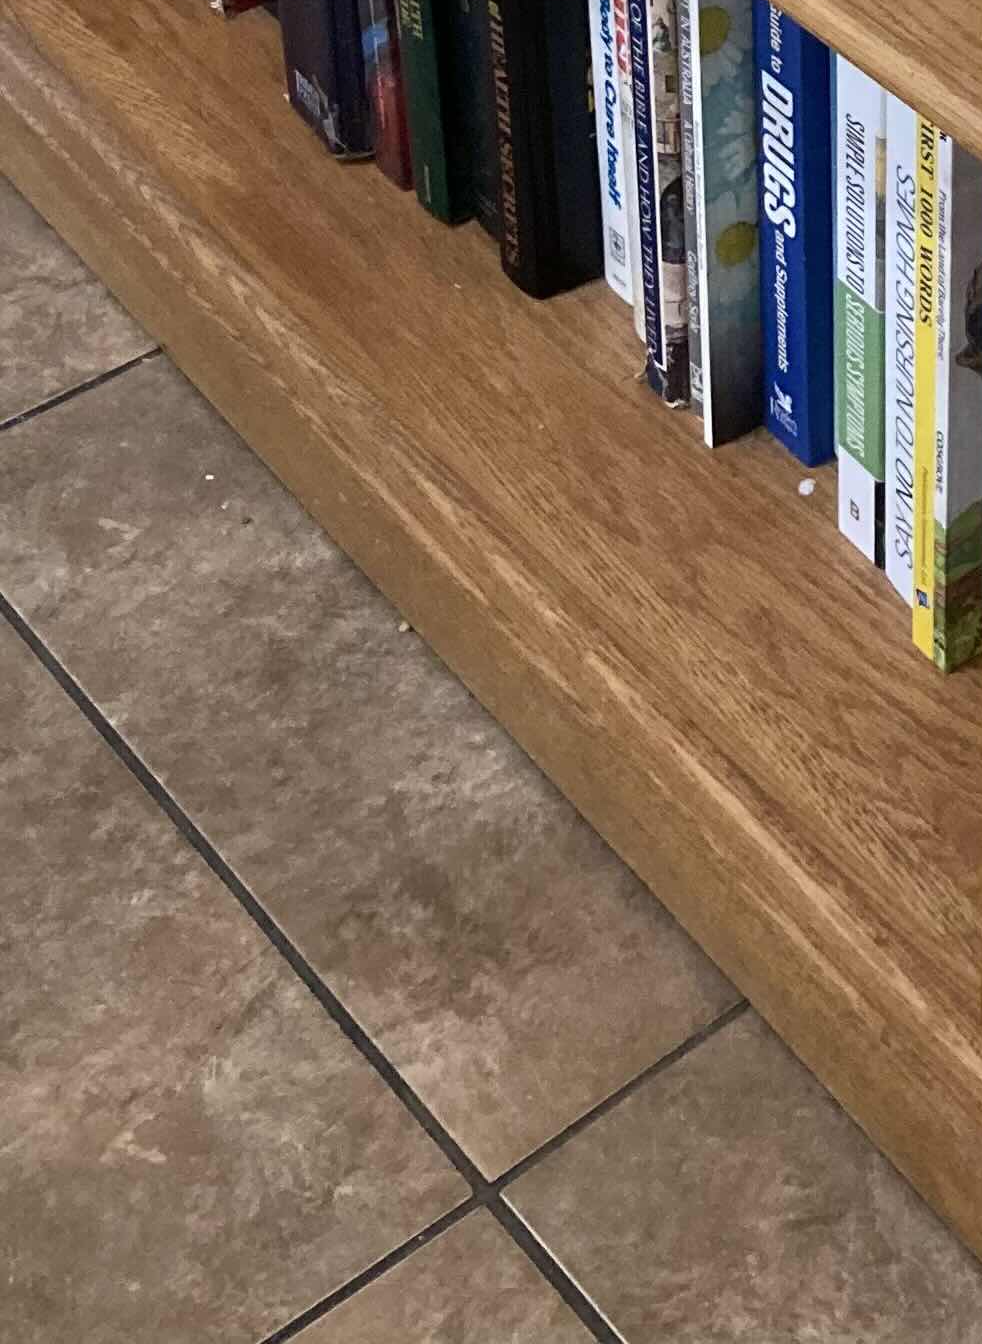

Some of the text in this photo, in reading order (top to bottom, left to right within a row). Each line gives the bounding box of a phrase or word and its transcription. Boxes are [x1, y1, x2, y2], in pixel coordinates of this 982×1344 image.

[630, 1, 645, 31] OF
[603, 56, 614, 74] to
[632, 35, 647, 71] THE
[680, 33, 694, 105] AUSTRALIA
[603, 77, 618, 138] Cure
[635, 78, 649, 129] BIBLE
[488, 20, 522, 269] HEALTH SECRETS
[636, 139, 653, 188] AND
[606, 140, 622, 210] Itself
[684, 174, 697, 217] History
[760, 2, 797, 373] Guide to DRUGS and Supplements
[639, 188, 655, 242] HOW
[918, 187, 936, 238] 1000
[643, 244, 657, 290] THEY
[844, 113, 866, 459] SIMPLE SOLUTIONS TO SERIOUS SYMPTOMS
[918, 245, 937, 330] WORDS
[894, 165, 917, 570] SAY NO TO NURSING HOMES
[935, 430, 945, 493] COSGROVE
